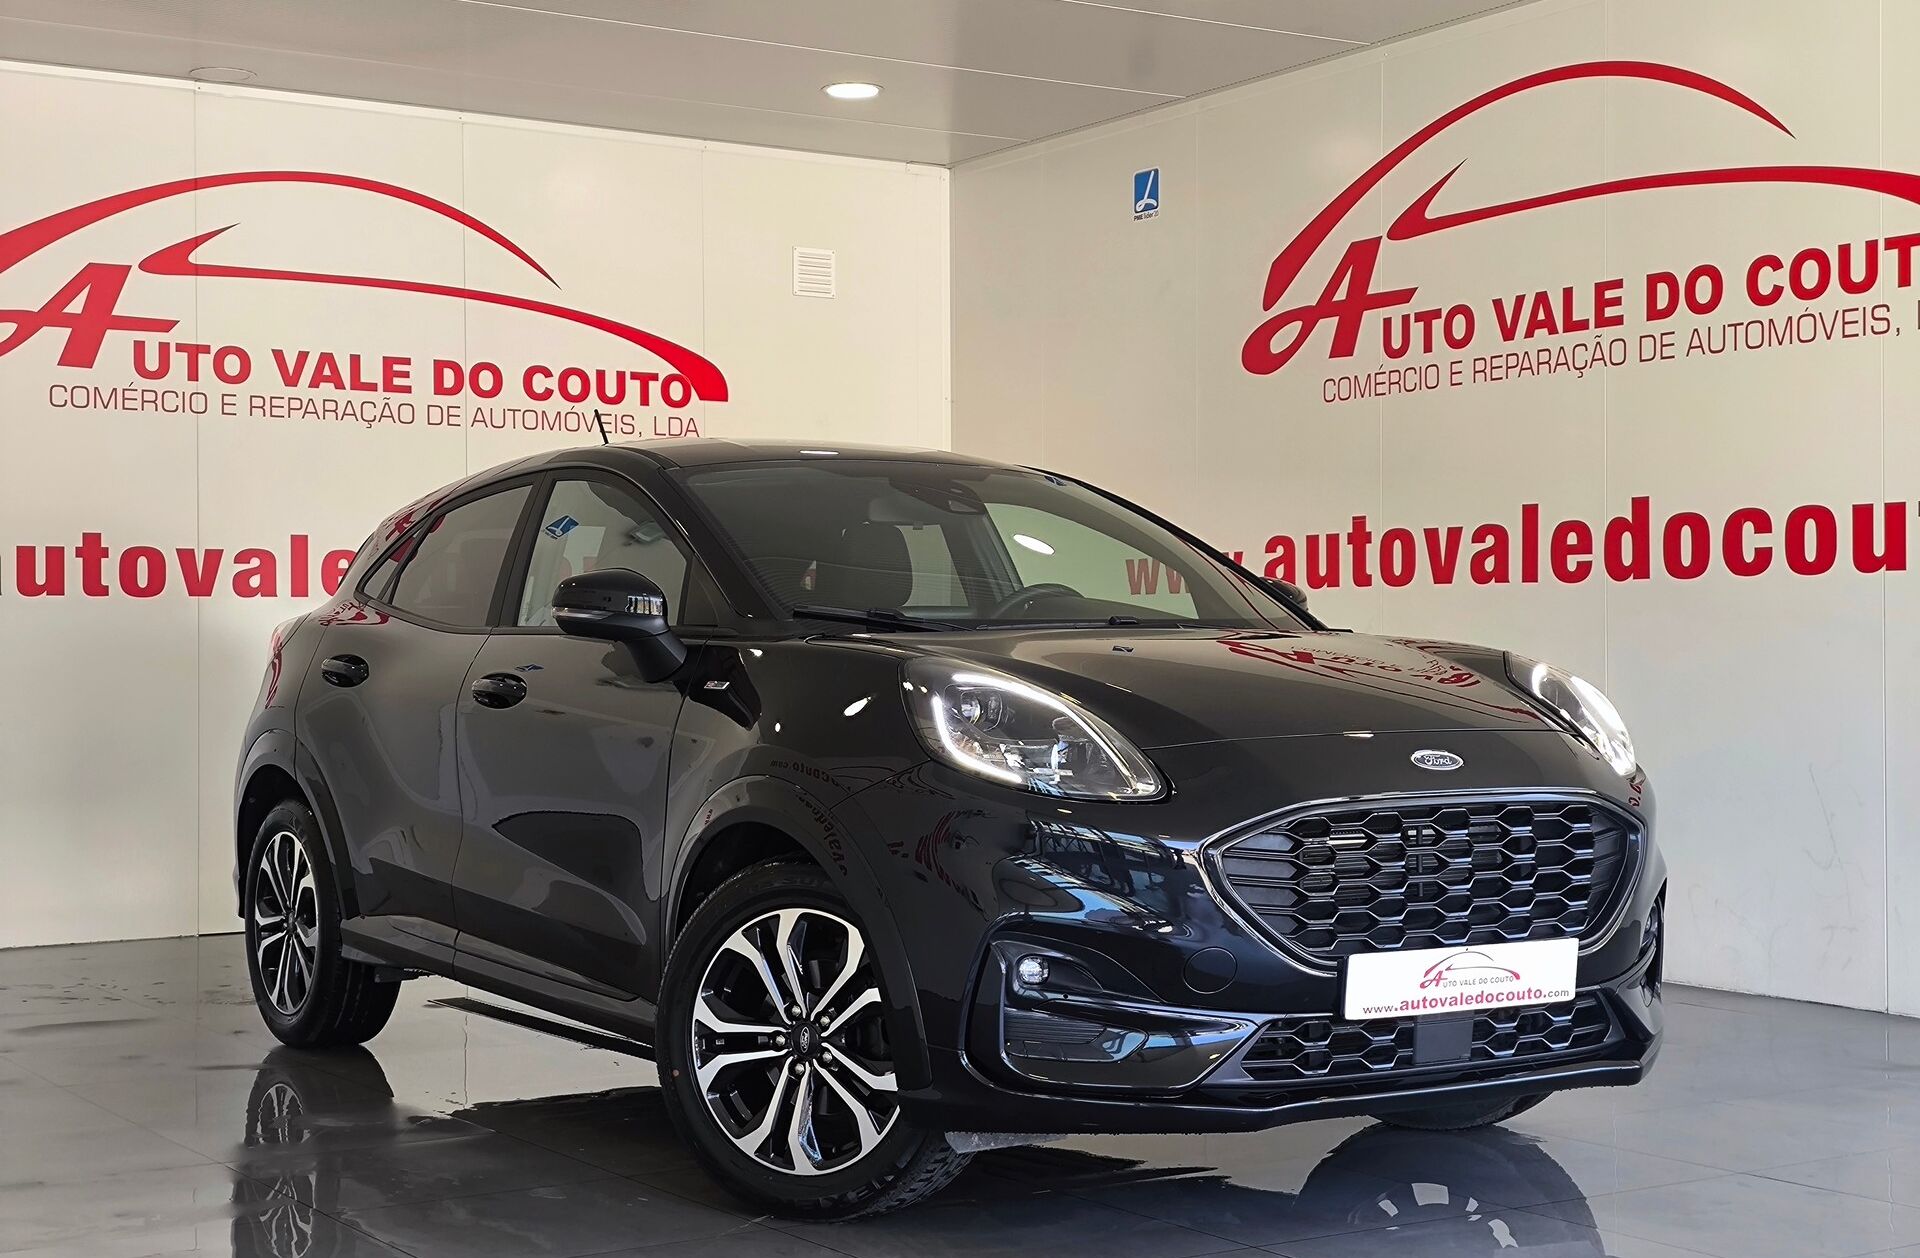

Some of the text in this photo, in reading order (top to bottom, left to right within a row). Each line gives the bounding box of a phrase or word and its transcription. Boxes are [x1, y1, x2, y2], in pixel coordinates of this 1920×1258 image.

[1241, 235, 1476, 375] AUTO
[1491, 278, 1625, 343] VALE
[1646, 263, 1724, 322] DO
[271, 348, 412, 394] VALE
[433, 358, 503, 401] DO
[522, 365, 692, 409] COUTO
[1322, 363, 1440, 403] COMÉRCIO
[1450, 360, 1464, 387] E
[1472, 334, 1627, 384] REPARAÇÃO
[1639, 331, 1676, 363] DE
[1686, 303, 1901, 357] AUTOMÓVEIS,
[49, 382, 699, 438] COMÉRCIO E REPARAÇÃO DE AUTOMÓVEIS, LDA
[0, 531, 357, 598] utovale
[1362, 986, 1570, 1015] www.autovaledocouto.com
[1459, 978, 1477, 987] VALE
[1478, 977, 1489, 985] DO
[1490, 975, 1515, 984] COUTO
